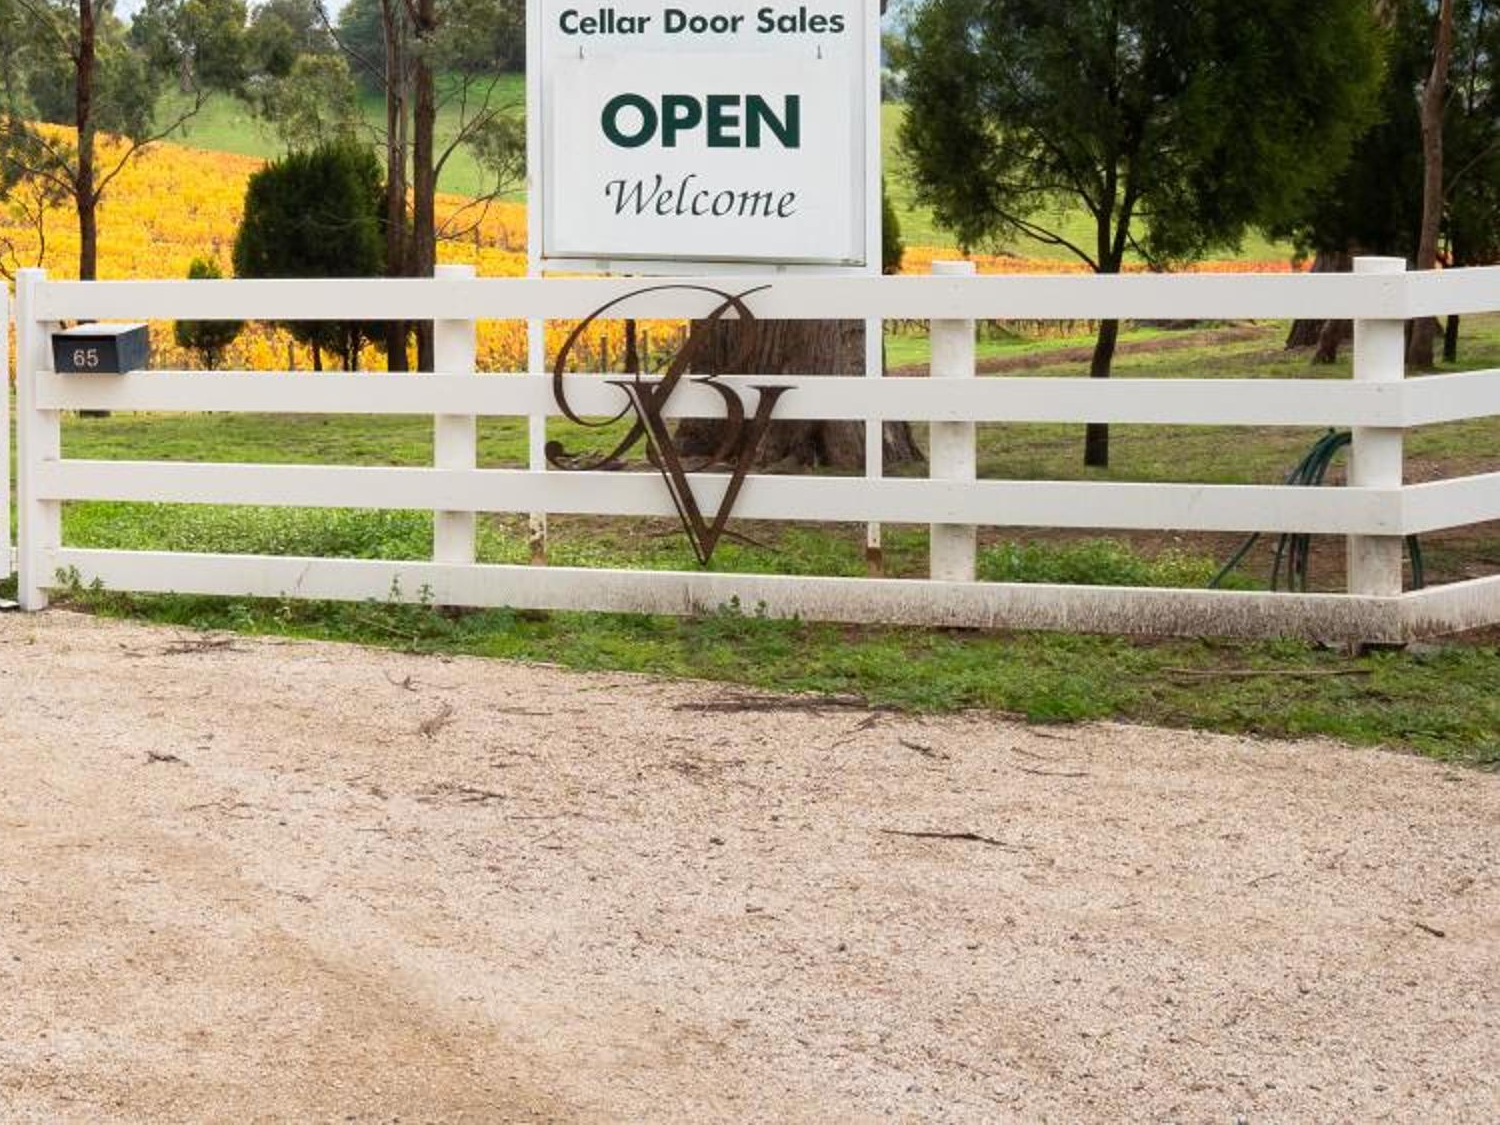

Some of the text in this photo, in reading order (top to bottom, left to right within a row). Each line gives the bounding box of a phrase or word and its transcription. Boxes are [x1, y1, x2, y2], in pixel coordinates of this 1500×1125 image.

[558, 6, 845, 35] Cellar Door Sales
[600, 93, 801, 149] OPEN
[605, 173, 798, 218] Welcome
[73, 348, 99, 367] 65
